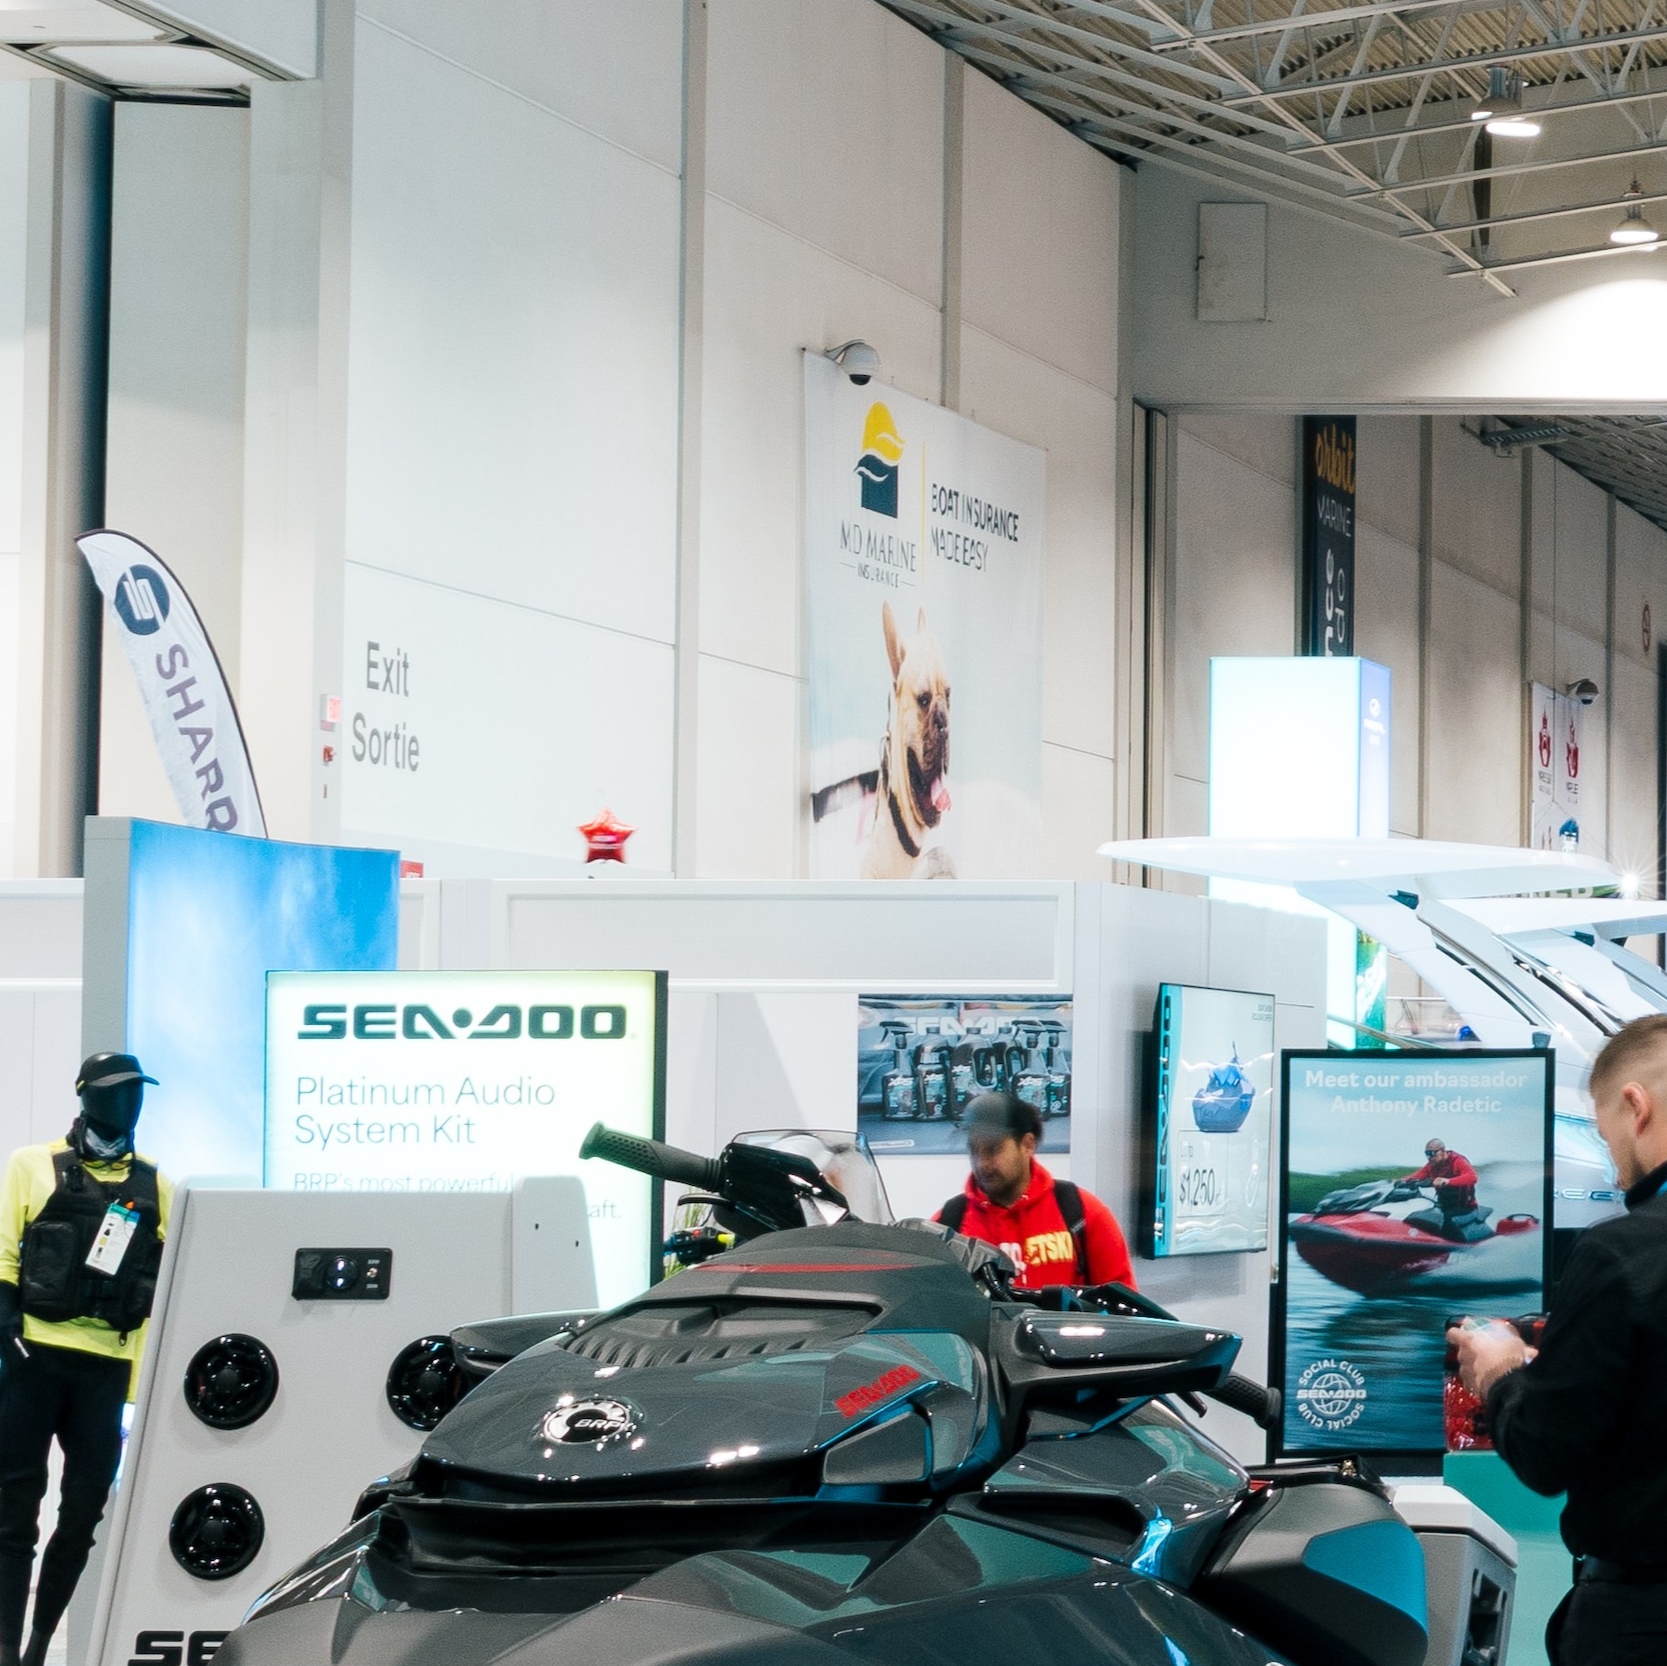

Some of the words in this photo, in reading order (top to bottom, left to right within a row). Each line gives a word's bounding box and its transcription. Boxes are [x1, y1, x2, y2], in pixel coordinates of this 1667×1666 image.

[931, 483, 959, 520] BOAT
[962, 494, 1019, 542] INSURANCE
[931, 526, 960, 563] MADE
[963, 539, 989, 572] EASY
[366, 640, 409, 698] Exit
[352, 711, 420, 772] Sortie
[297, 1075, 445, 1106] Platinum
[455, 1075, 556, 1106] Audio
[1305, 1070, 1360, 1088] Meet
[1364, 1073, 1399, 1088] our
[1404, 1070, 1527, 1088] ambassador
[1330, 1095, 1419, 1117] Anthony
[1423, 1095, 1502, 1113] Radetic
[294, 1114, 421, 1151] System
[433, 1114, 476, 1144] Kit
[1298, 1358, 1338, 1386] SOCIAL
[1339, 1360, 1365, 1386] CLUB
[575, 1418, 623, 1430] BRP
[1298, 1402, 1324, 1428] CLUB
[1326, 1402, 1365, 1431] SOCIAL
